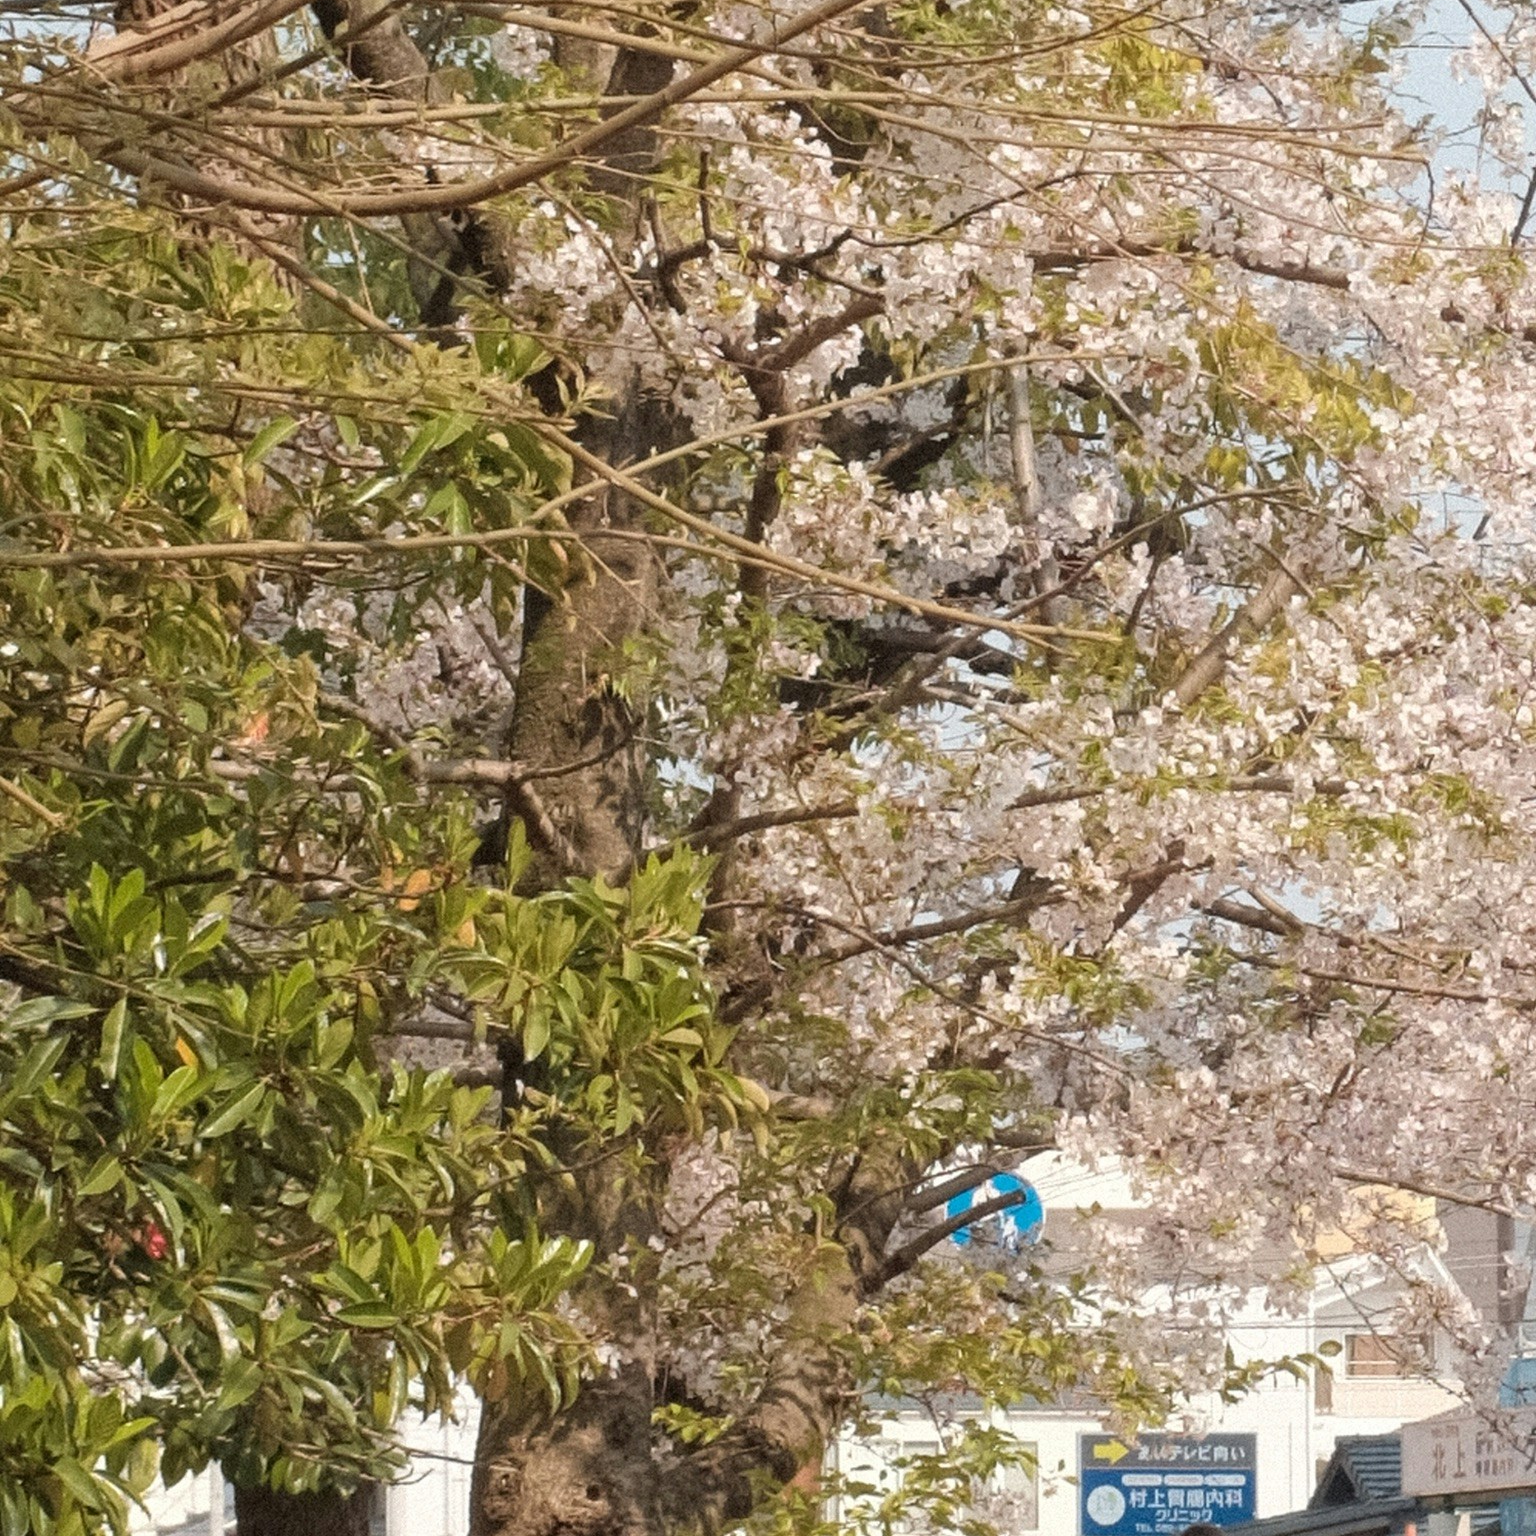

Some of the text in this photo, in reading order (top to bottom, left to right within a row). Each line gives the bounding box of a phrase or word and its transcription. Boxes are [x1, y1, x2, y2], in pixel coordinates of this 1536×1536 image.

[1155, 1508, 1213, 1522] クリニック
